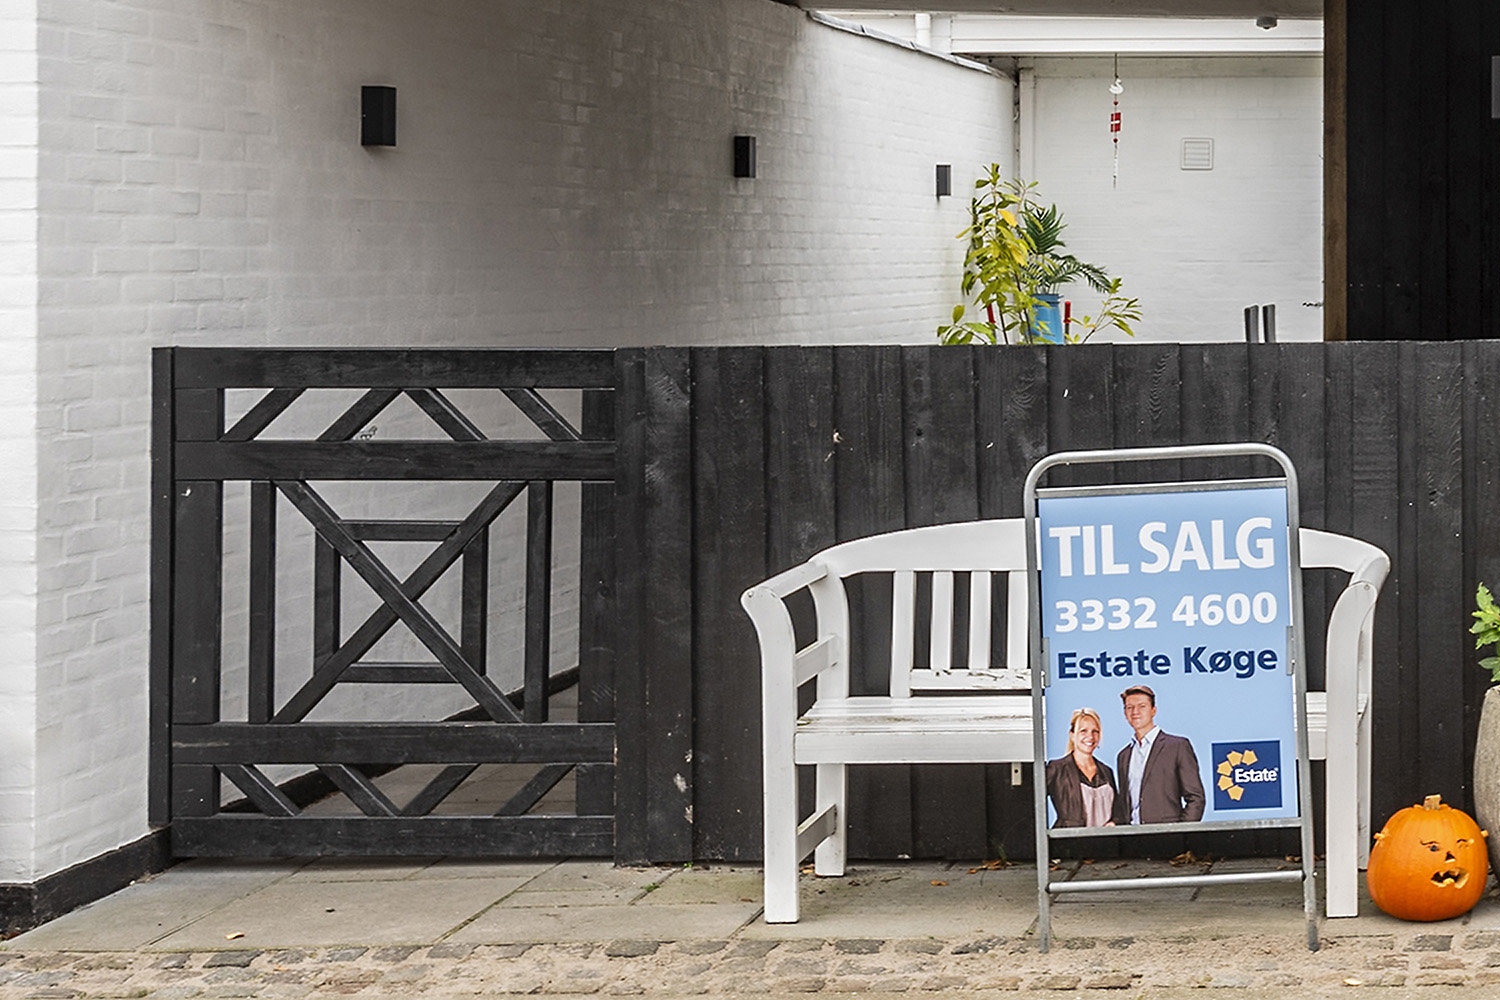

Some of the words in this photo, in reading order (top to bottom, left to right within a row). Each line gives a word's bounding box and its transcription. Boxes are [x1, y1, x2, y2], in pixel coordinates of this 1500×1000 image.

[1048, 523, 1129, 577] TIL
[1138, 517, 1275, 575] SALG
[1055, 596, 1157, 633] 3332
[1172, 591, 1277, 627] 4600
[1057, 649, 1171, 679] Estate
[1183, 645, 1278, 679] Køge
[1234, 768, 1278, 783] Estate
